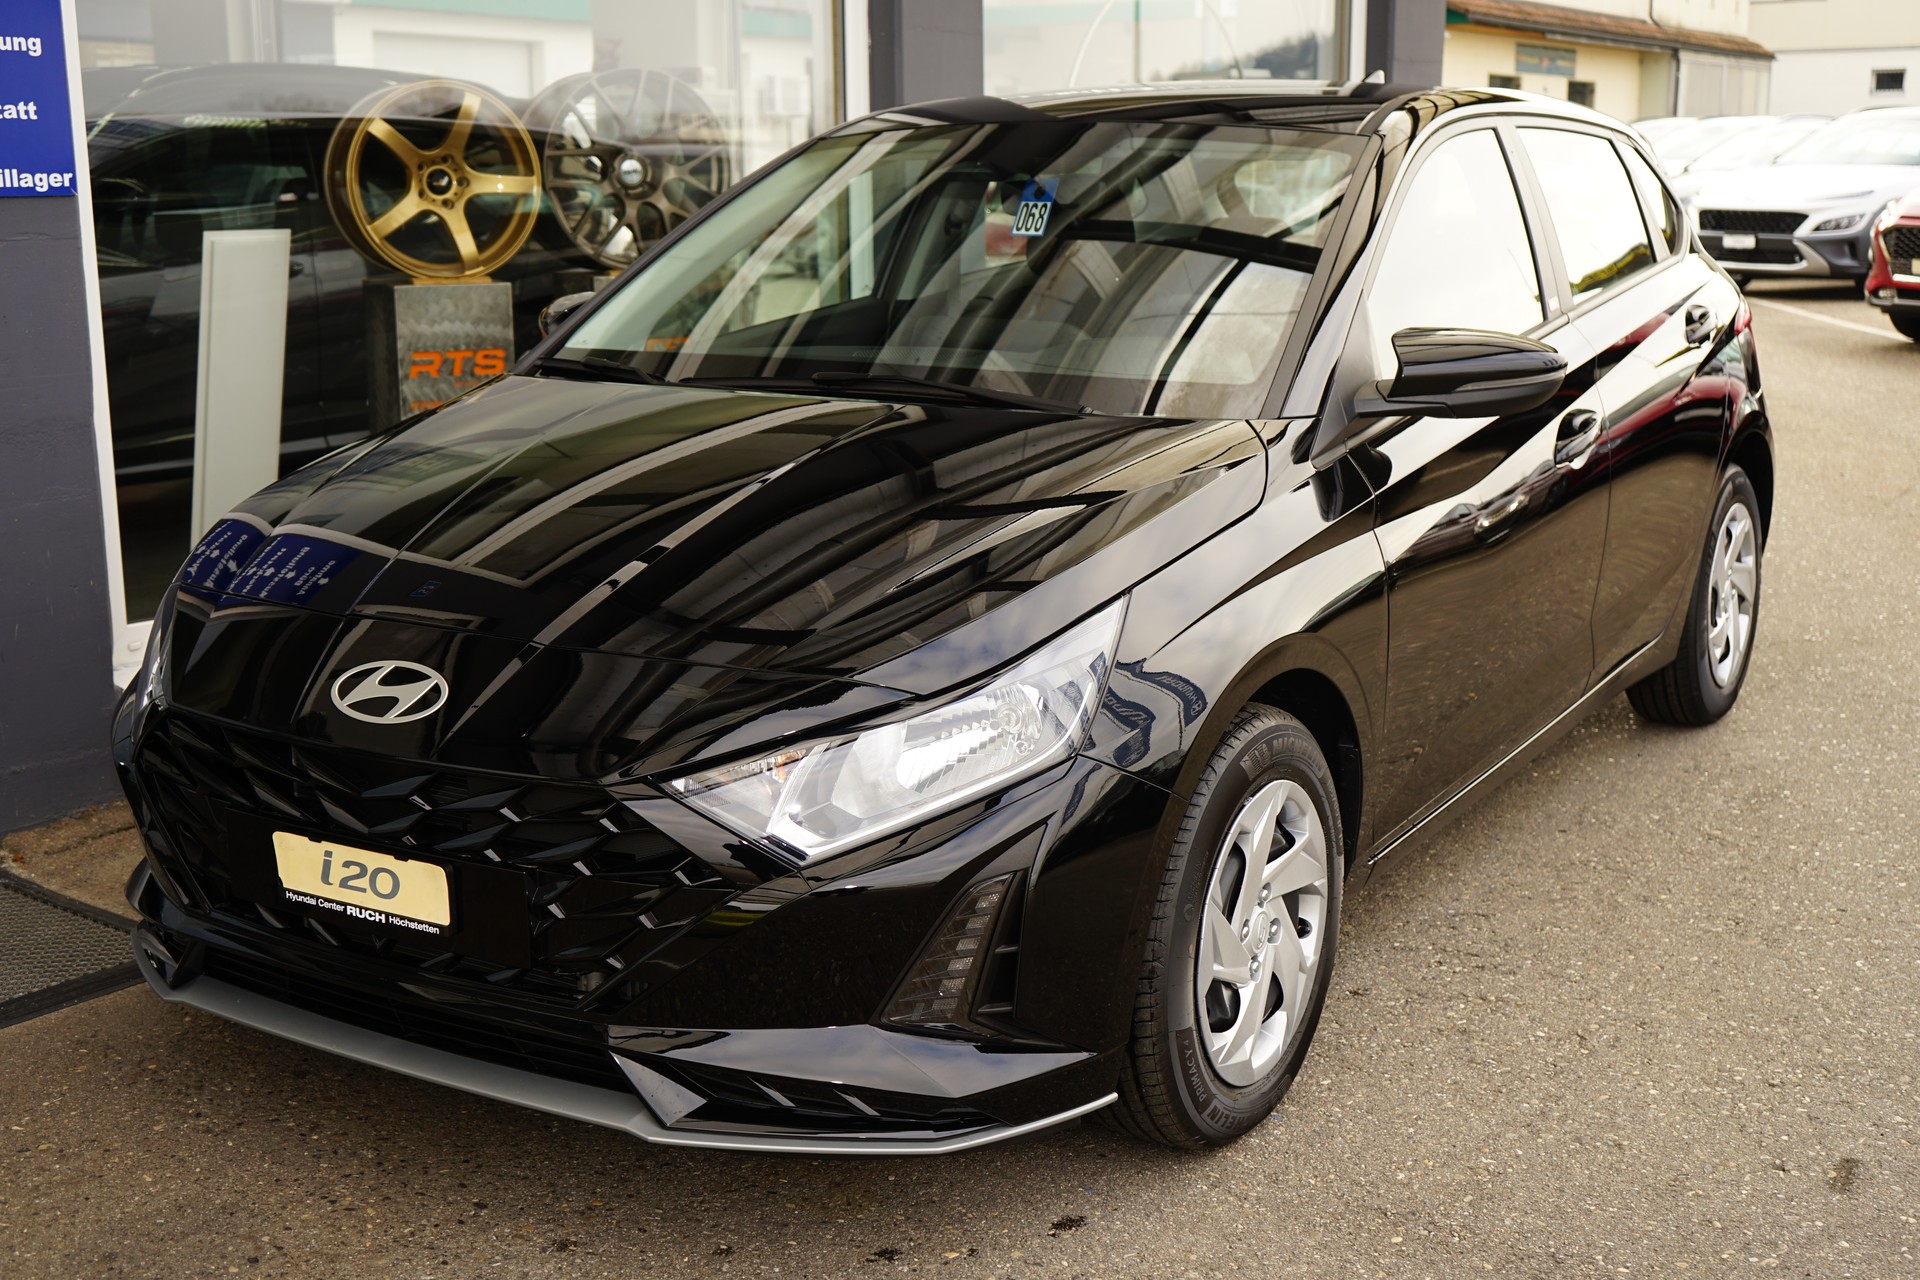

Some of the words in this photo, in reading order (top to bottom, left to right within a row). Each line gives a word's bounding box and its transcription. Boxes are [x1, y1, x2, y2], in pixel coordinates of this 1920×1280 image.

[1016, 202, 1048, 232] 068
[409, 348, 507, 379] RTS
[320, 850, 401, 900] i20
[286, 890, 317, 906] Hyundai
[317, 898, 345, 912] Center
[346, 905, 386, 923] RUCH
[389, 915, 440, 935] Höchstetten
[1184, 1049, 1208, 1102] PRIMACY
